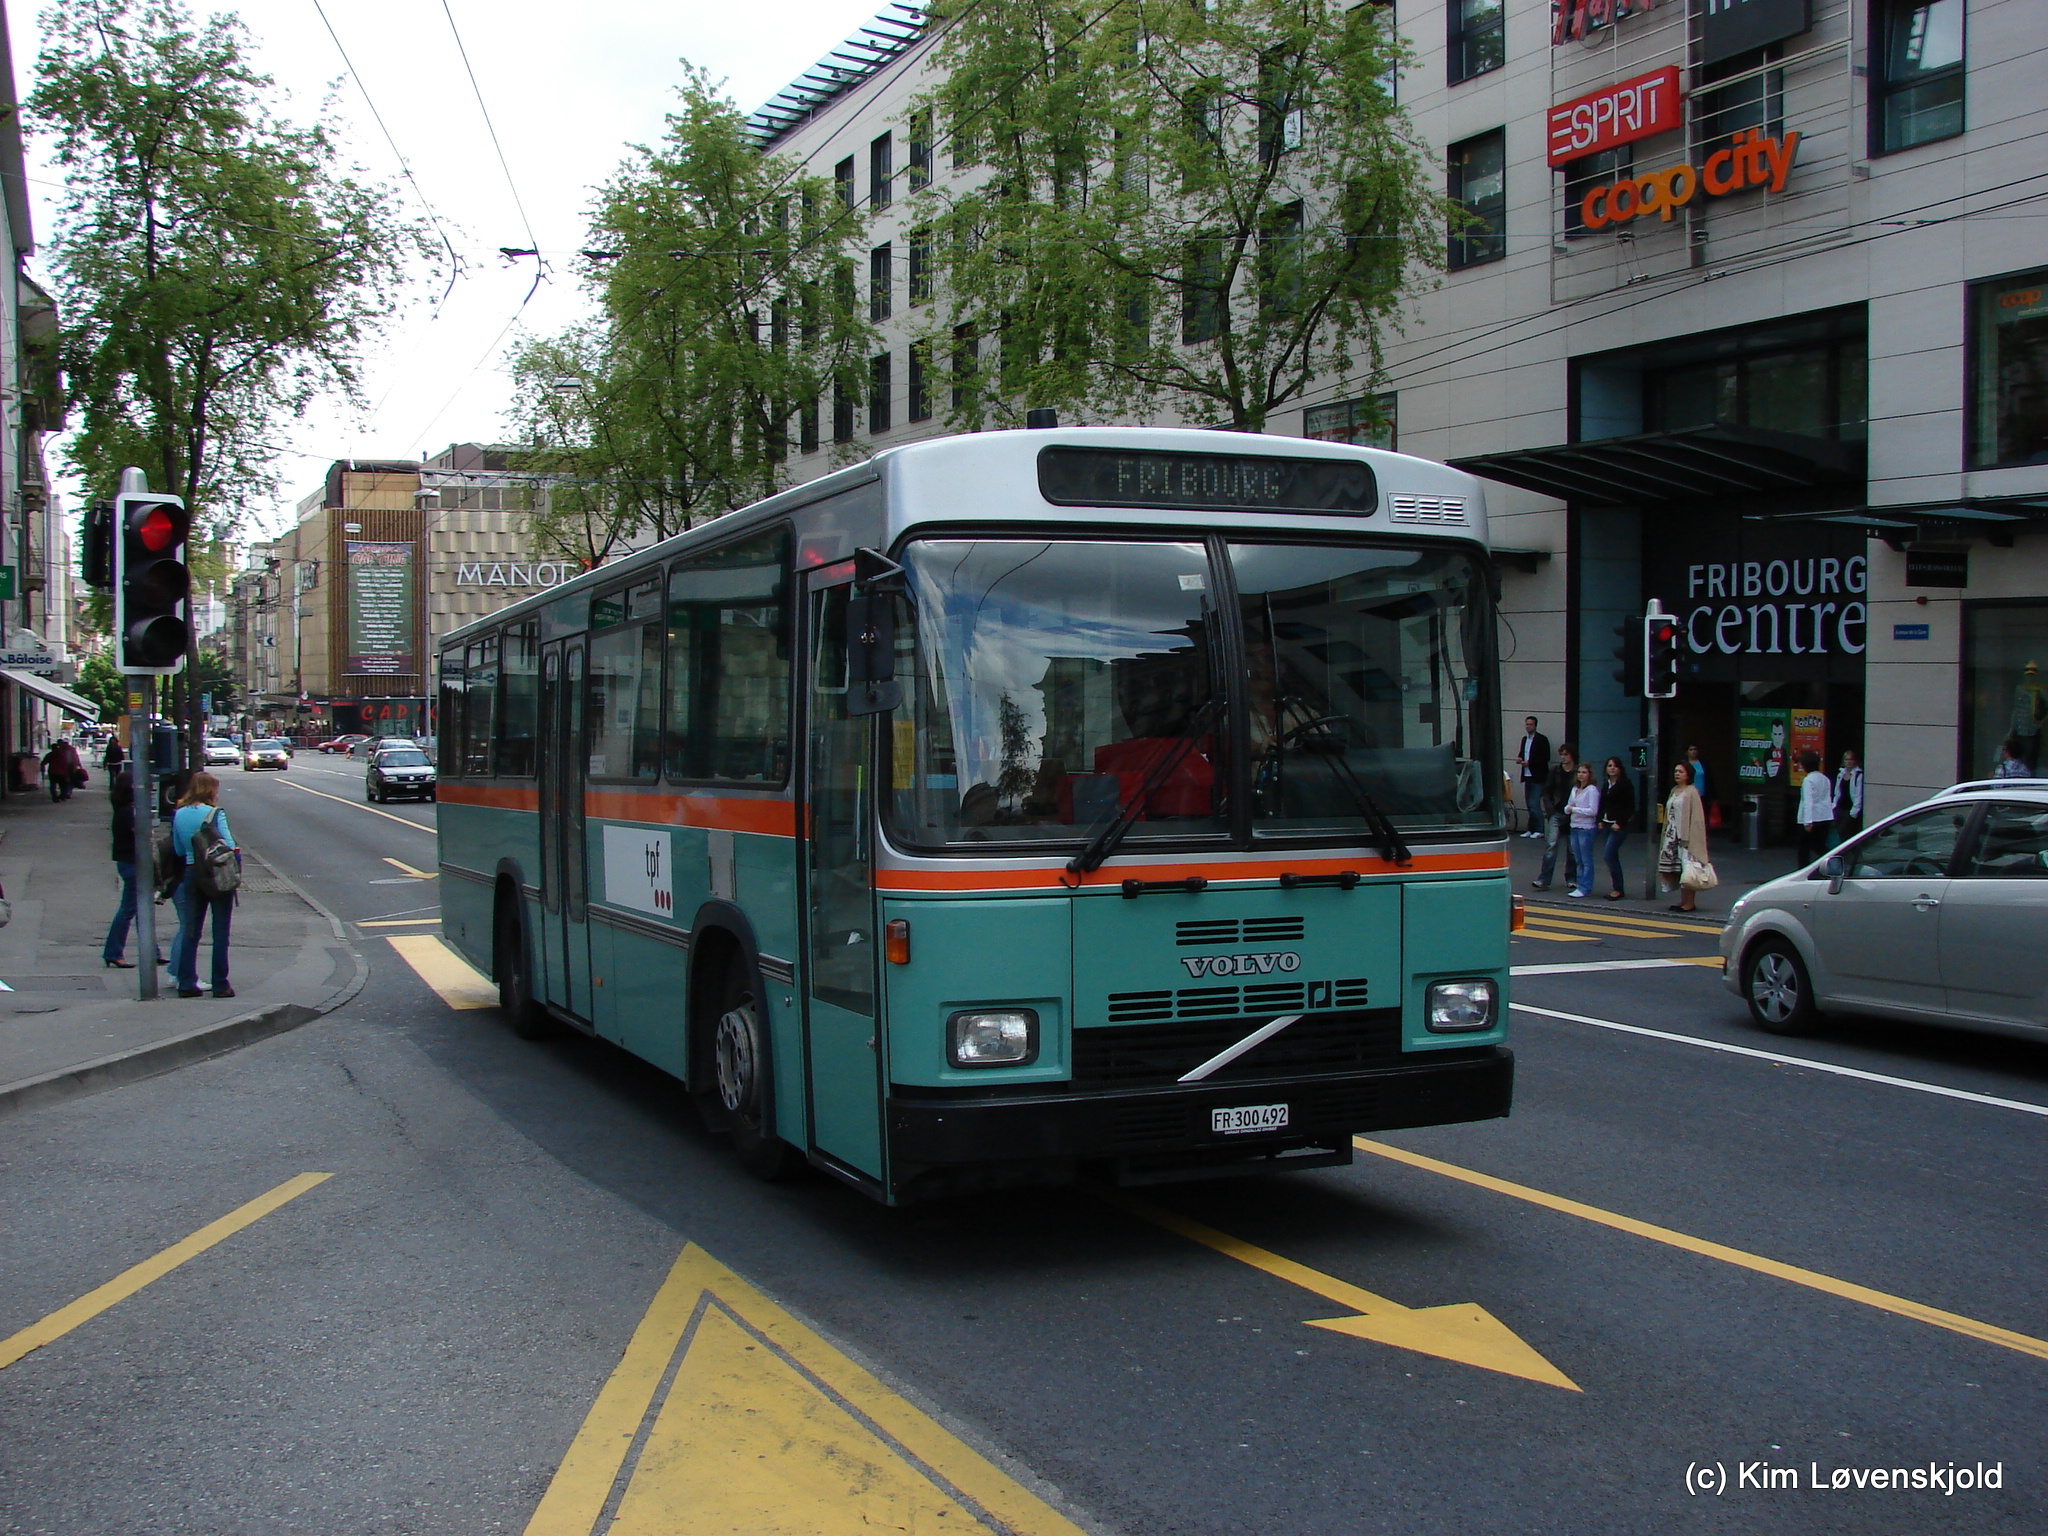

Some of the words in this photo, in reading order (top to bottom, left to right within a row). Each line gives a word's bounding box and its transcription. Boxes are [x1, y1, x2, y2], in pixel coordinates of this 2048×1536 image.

[1552, 77, 1664, 156] ESPRIT
[1581, 164, 1696, 229] coop
[1702, 128, 1800, 195] city
[1118, 459, 1279, 499] FRIBOURG
[1688, 555, 1867, 598] FRIBOURG
[1687, 601, 1867, 655] centre
[8, 654, 53, 665] Bâloise
[645, 840, 660, 887] tpf
[1181, 952, 1301, 978] VOLVO
